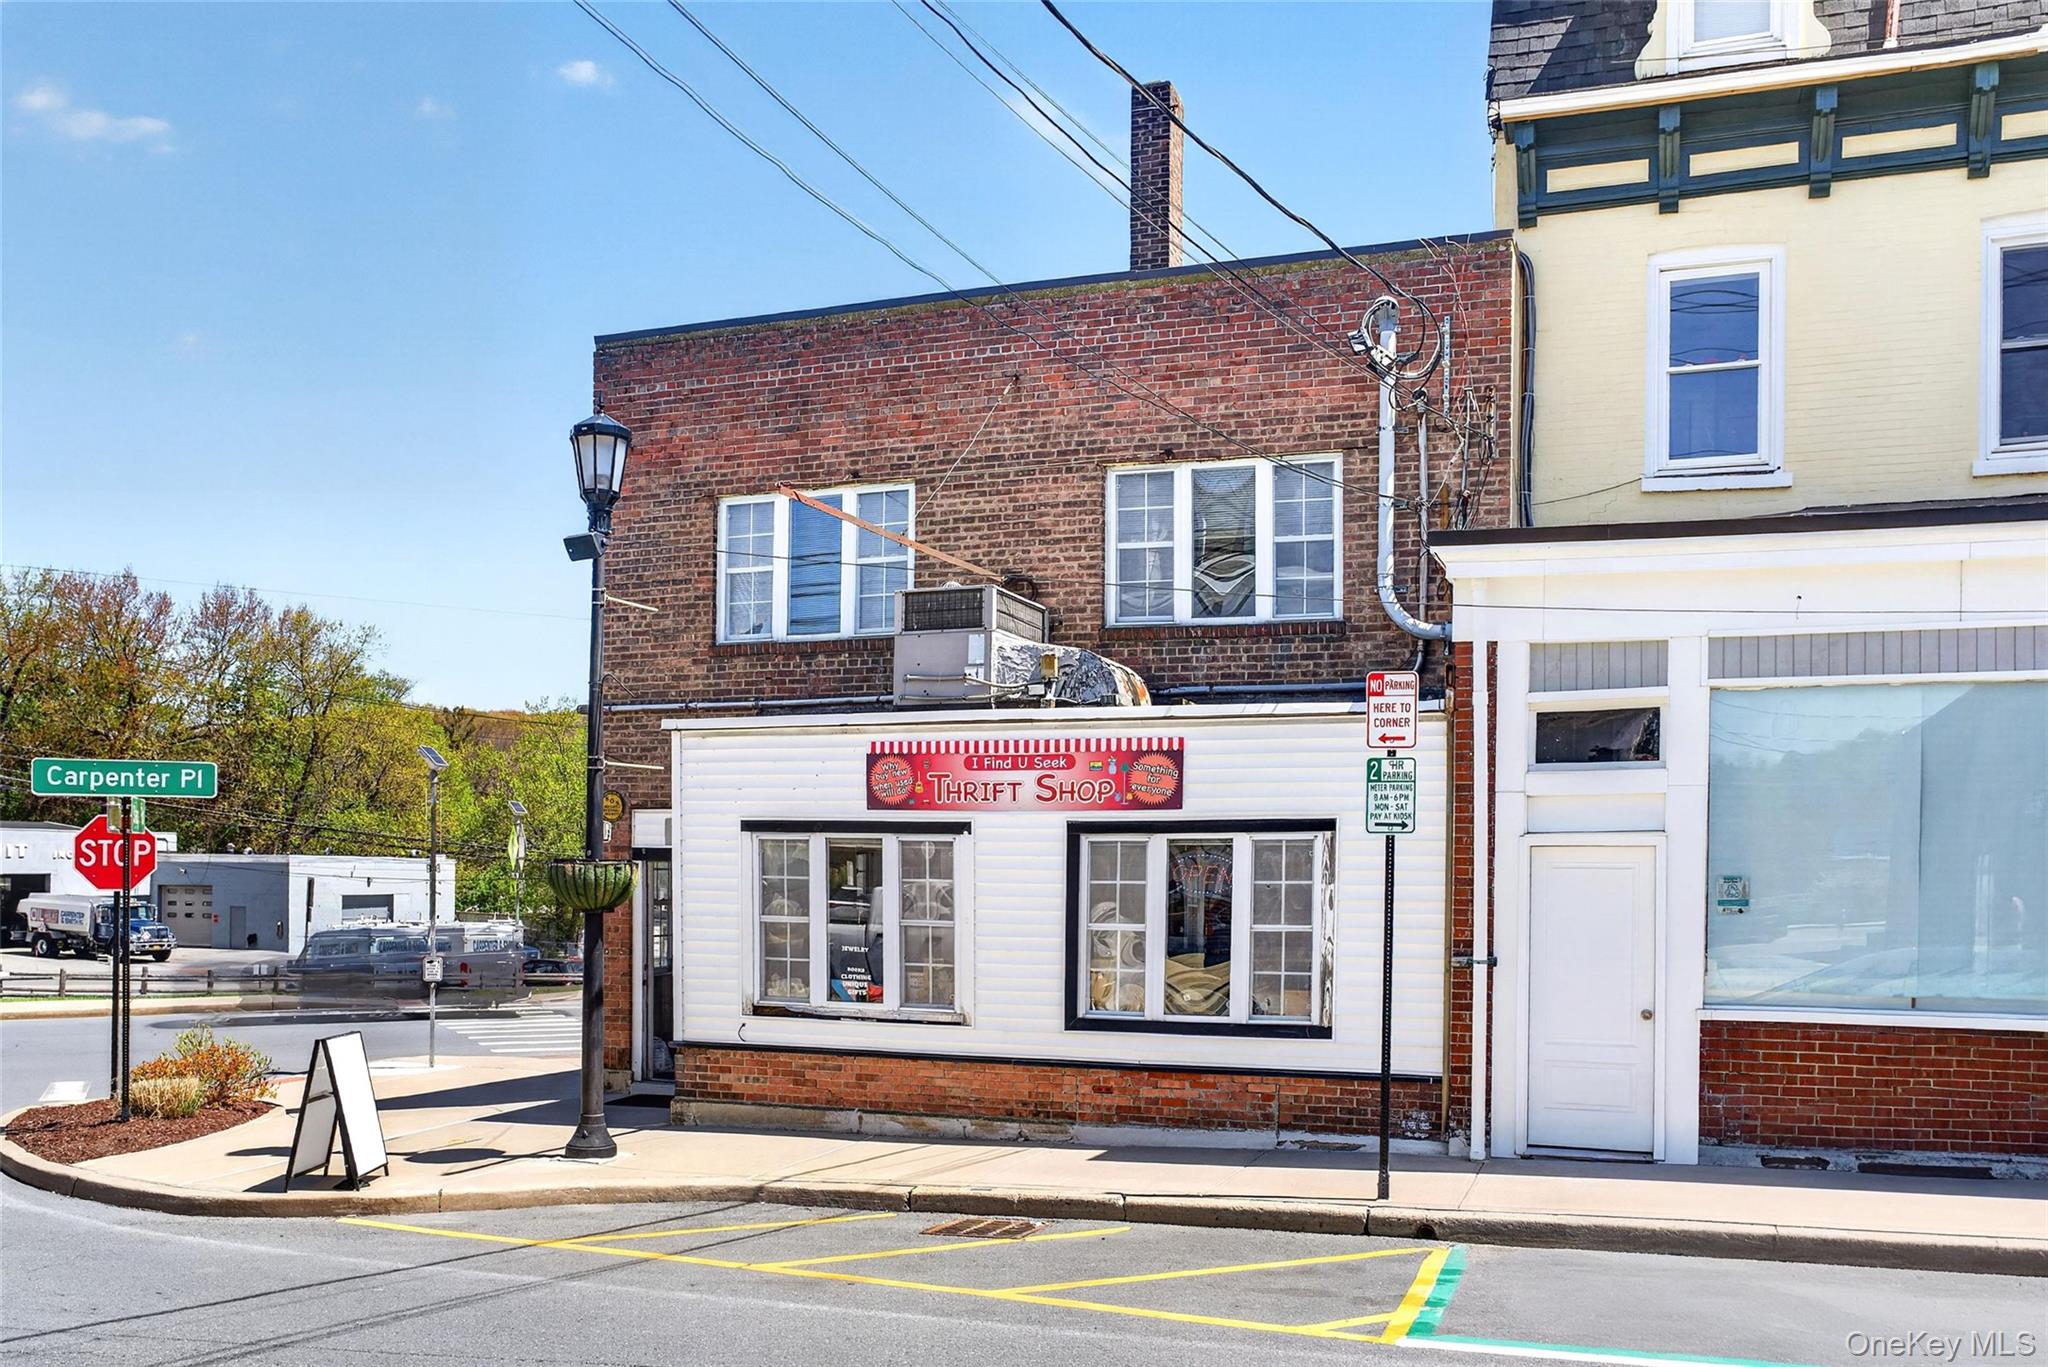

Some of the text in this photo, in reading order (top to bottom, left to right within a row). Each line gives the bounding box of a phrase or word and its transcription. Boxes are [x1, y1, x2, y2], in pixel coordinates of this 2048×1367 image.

[1370, 679, 1415, 692] NO PARKING
[1373, 702, 1411, 713] HERE TO
[1374, 717, 1411, 728] CORNER
[880, 762, 899, 772] Why
[971, 757, 1067, 769] I Find U Seek
[1390, 760, 1405, 771] HR
[874, 768, 908, 781] buy new
[1132, 761, 1180, 779] Something
[1370, 761, 1379, 780] 2
[1383, 771, 1413, 780] PARKING
[47, 765, 203, 791] Carpenter Pl
[1147, 773, 1161, 784] for
[872, 777, 913, 791] when used
[927, 772, 1115, 804] THRIFT SHOP
[1370, 783, 1414, 792] METER PARKING
[880, 788, 895, 797] will
[1131, 783, 1173, 797] everyone
[1374, 803, 1390, 811] MON
[1395, 803, 1409, 811] SAT
[1370, 812, 1413, 821] PAY AT KIOSK
[79, 838, 152, 867] STOP
[1172, 864, 1233, 891] OPEN
[840, 973, 872, 981] CLOTHING
